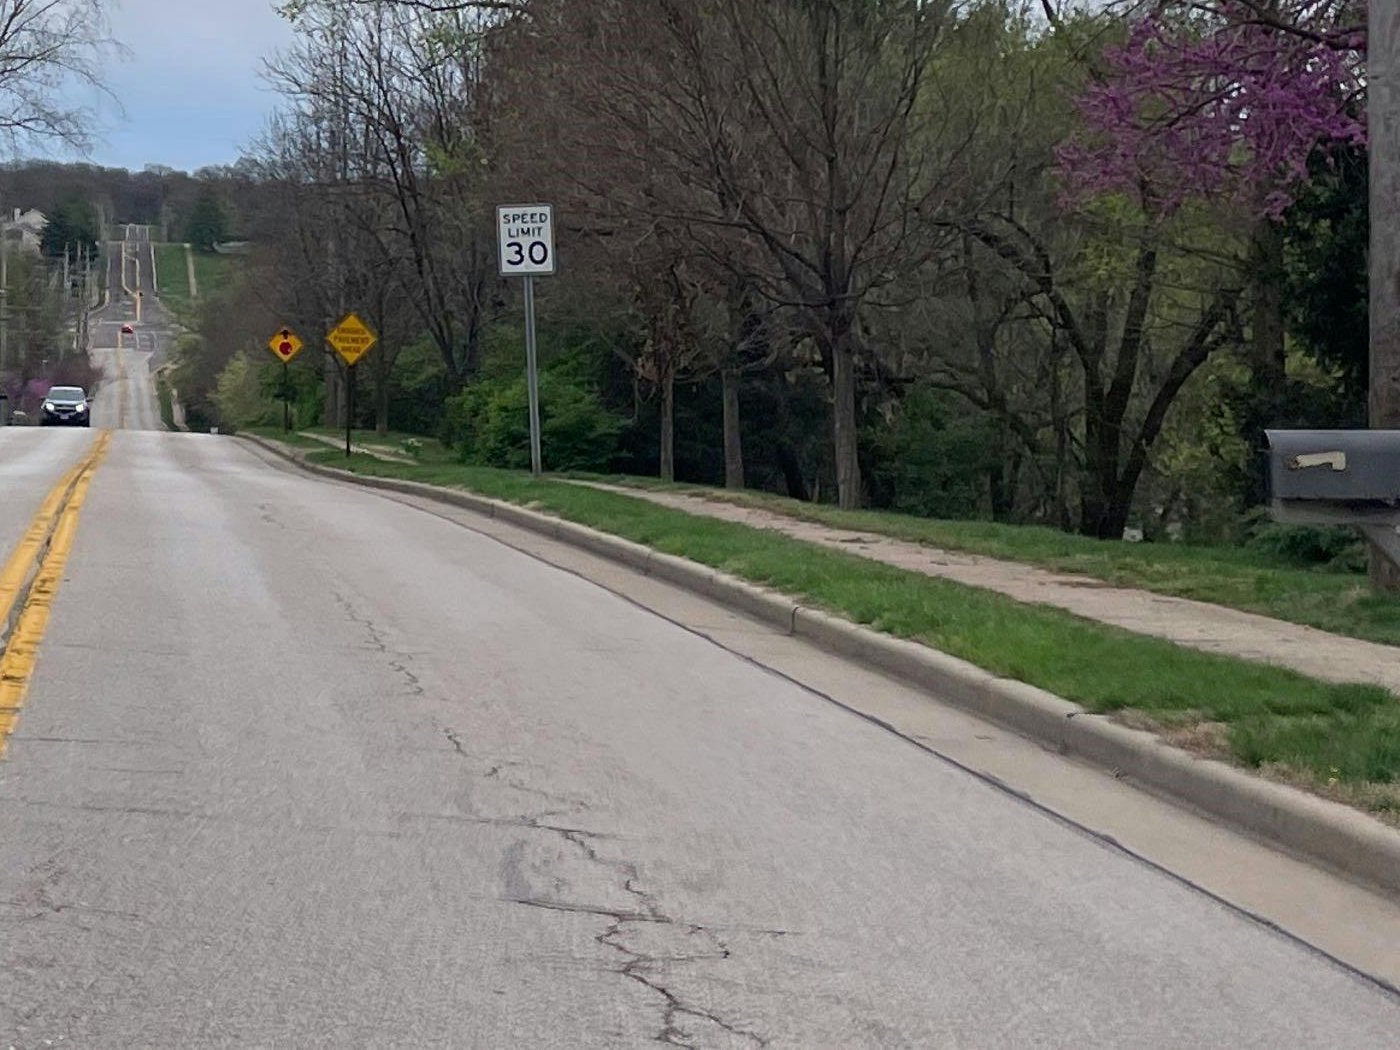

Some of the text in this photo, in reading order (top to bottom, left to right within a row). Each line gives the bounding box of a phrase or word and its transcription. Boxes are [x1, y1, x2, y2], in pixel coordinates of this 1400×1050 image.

[503, 213, 548, 224] SPEED
[508, 226, 543, 238] LIMIT
[506, 240, 548, 266] 30
